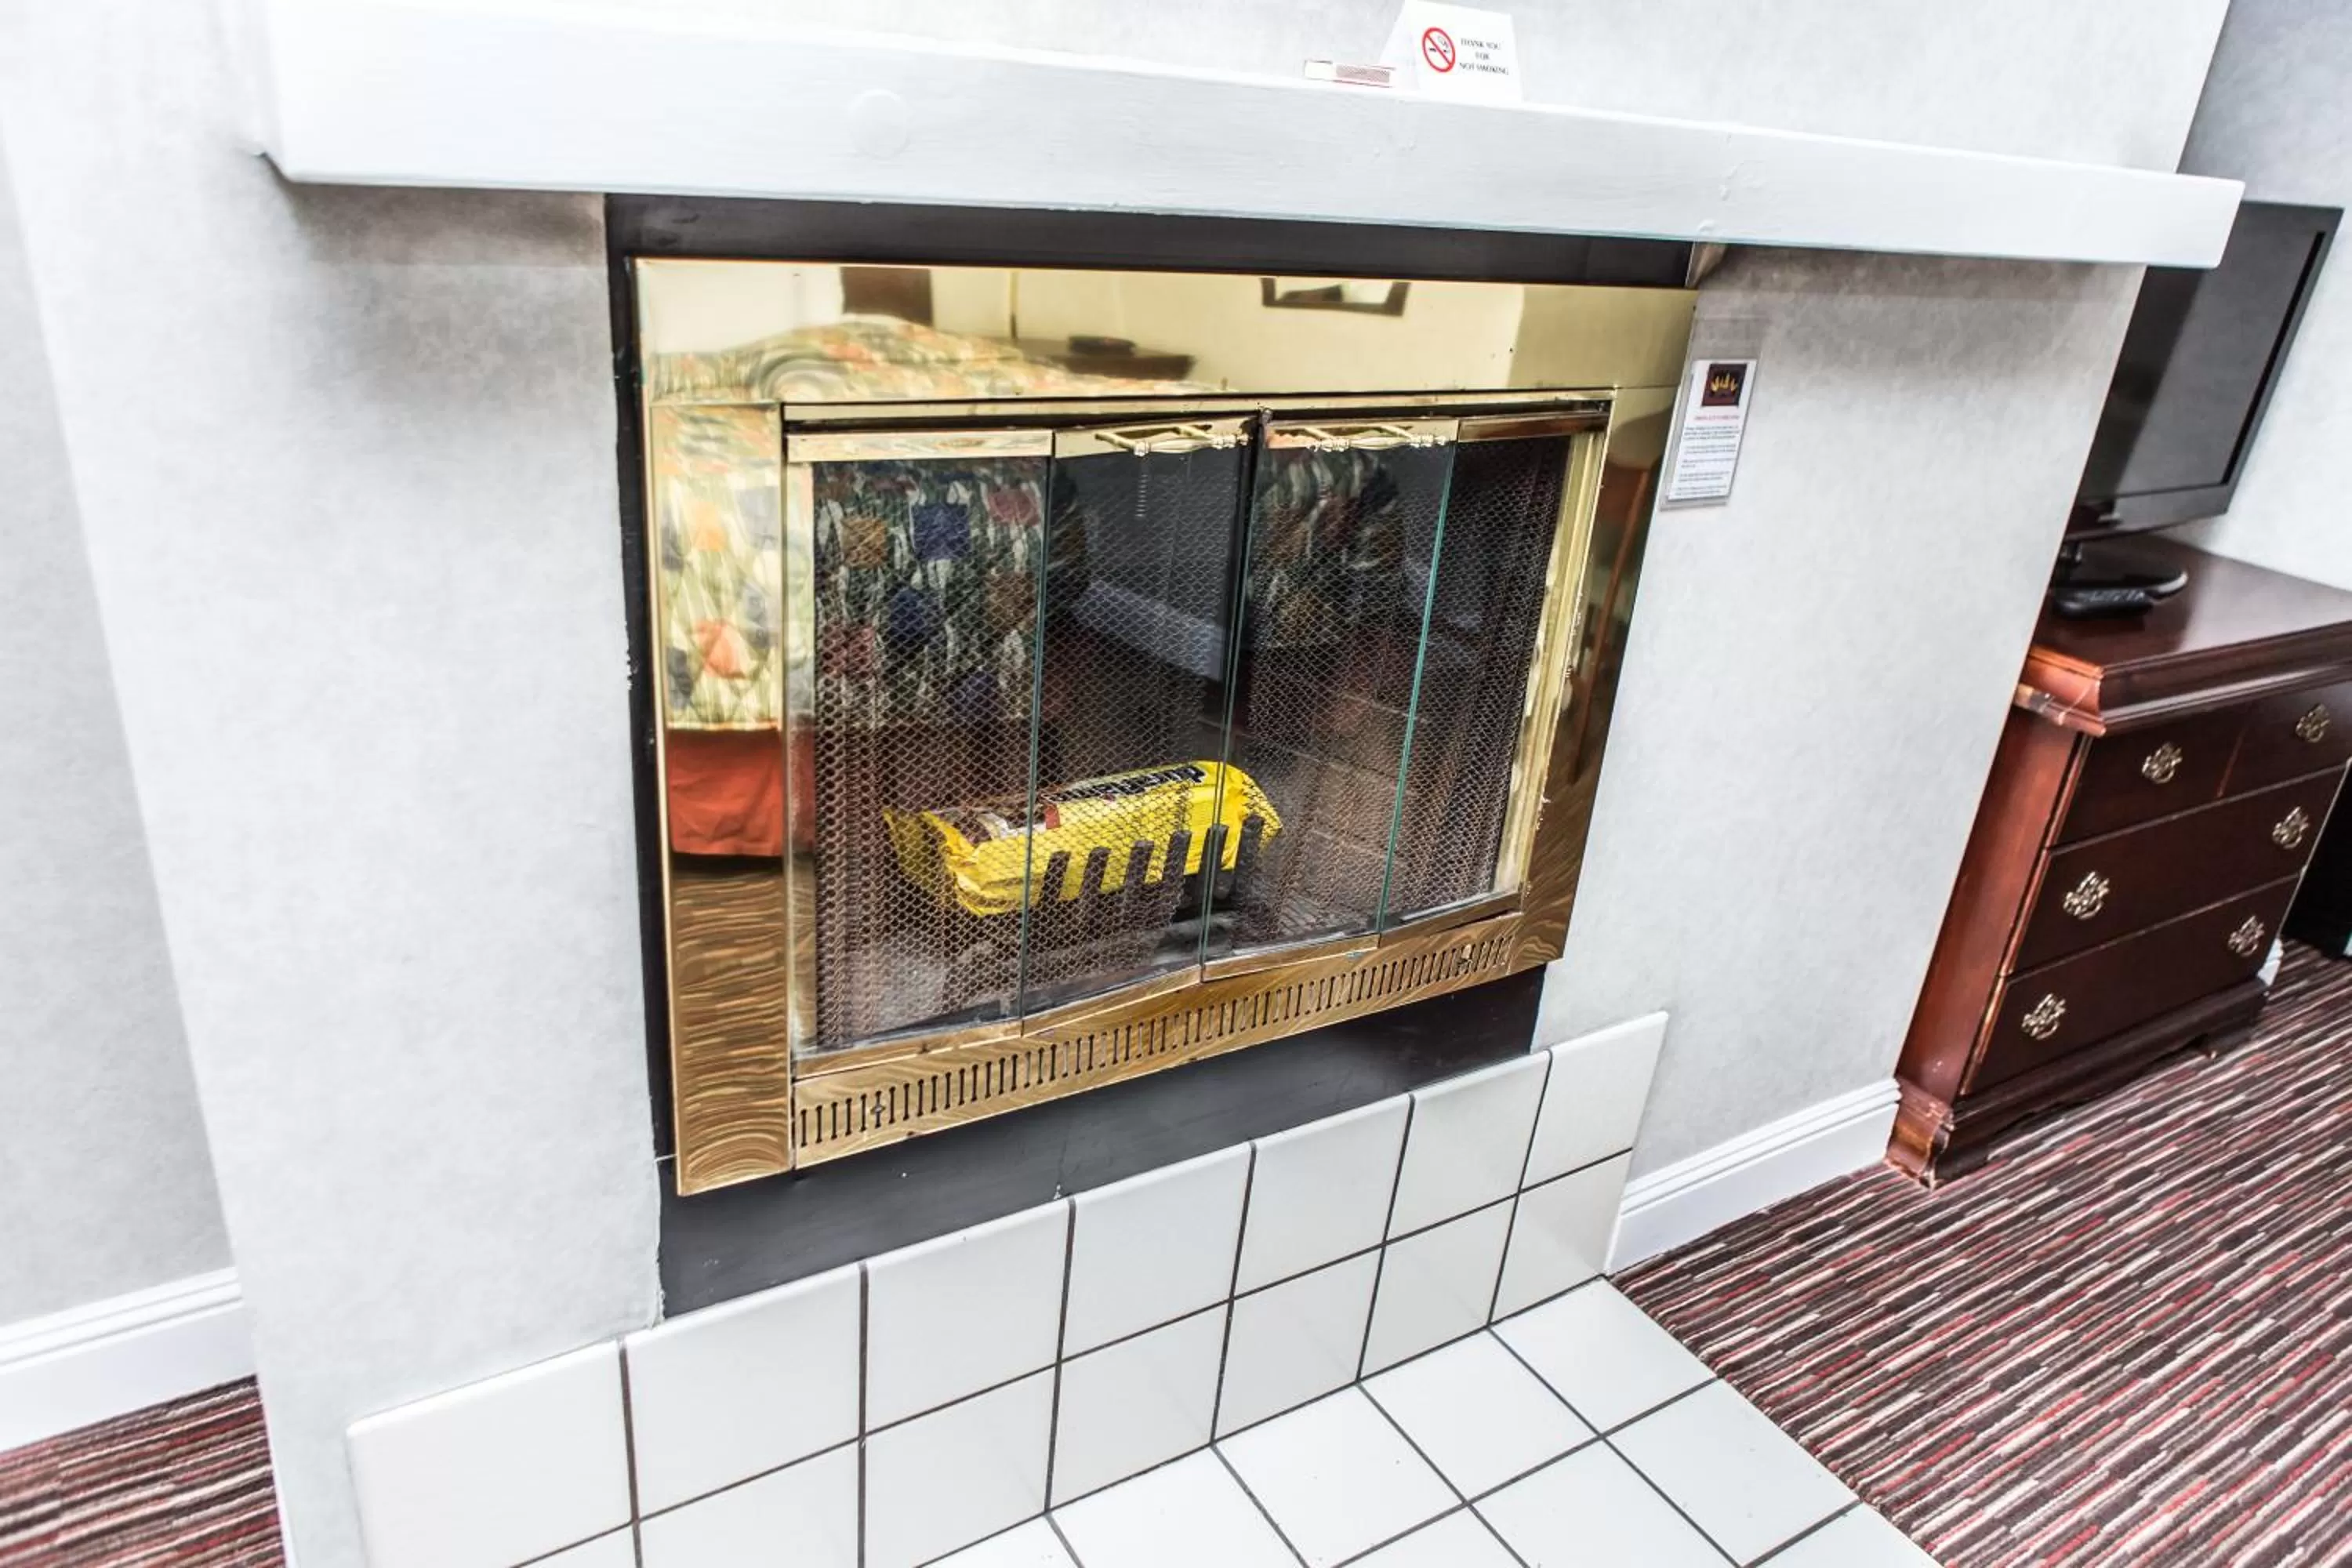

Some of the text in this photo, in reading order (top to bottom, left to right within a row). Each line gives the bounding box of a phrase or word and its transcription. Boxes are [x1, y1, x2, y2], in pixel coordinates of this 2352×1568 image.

[1461, 38, 1501, 50] THANK YOU
[1475, 52, 1490, 60] FOR
[1460, 63, 1509, 76] NOT SMOKING
